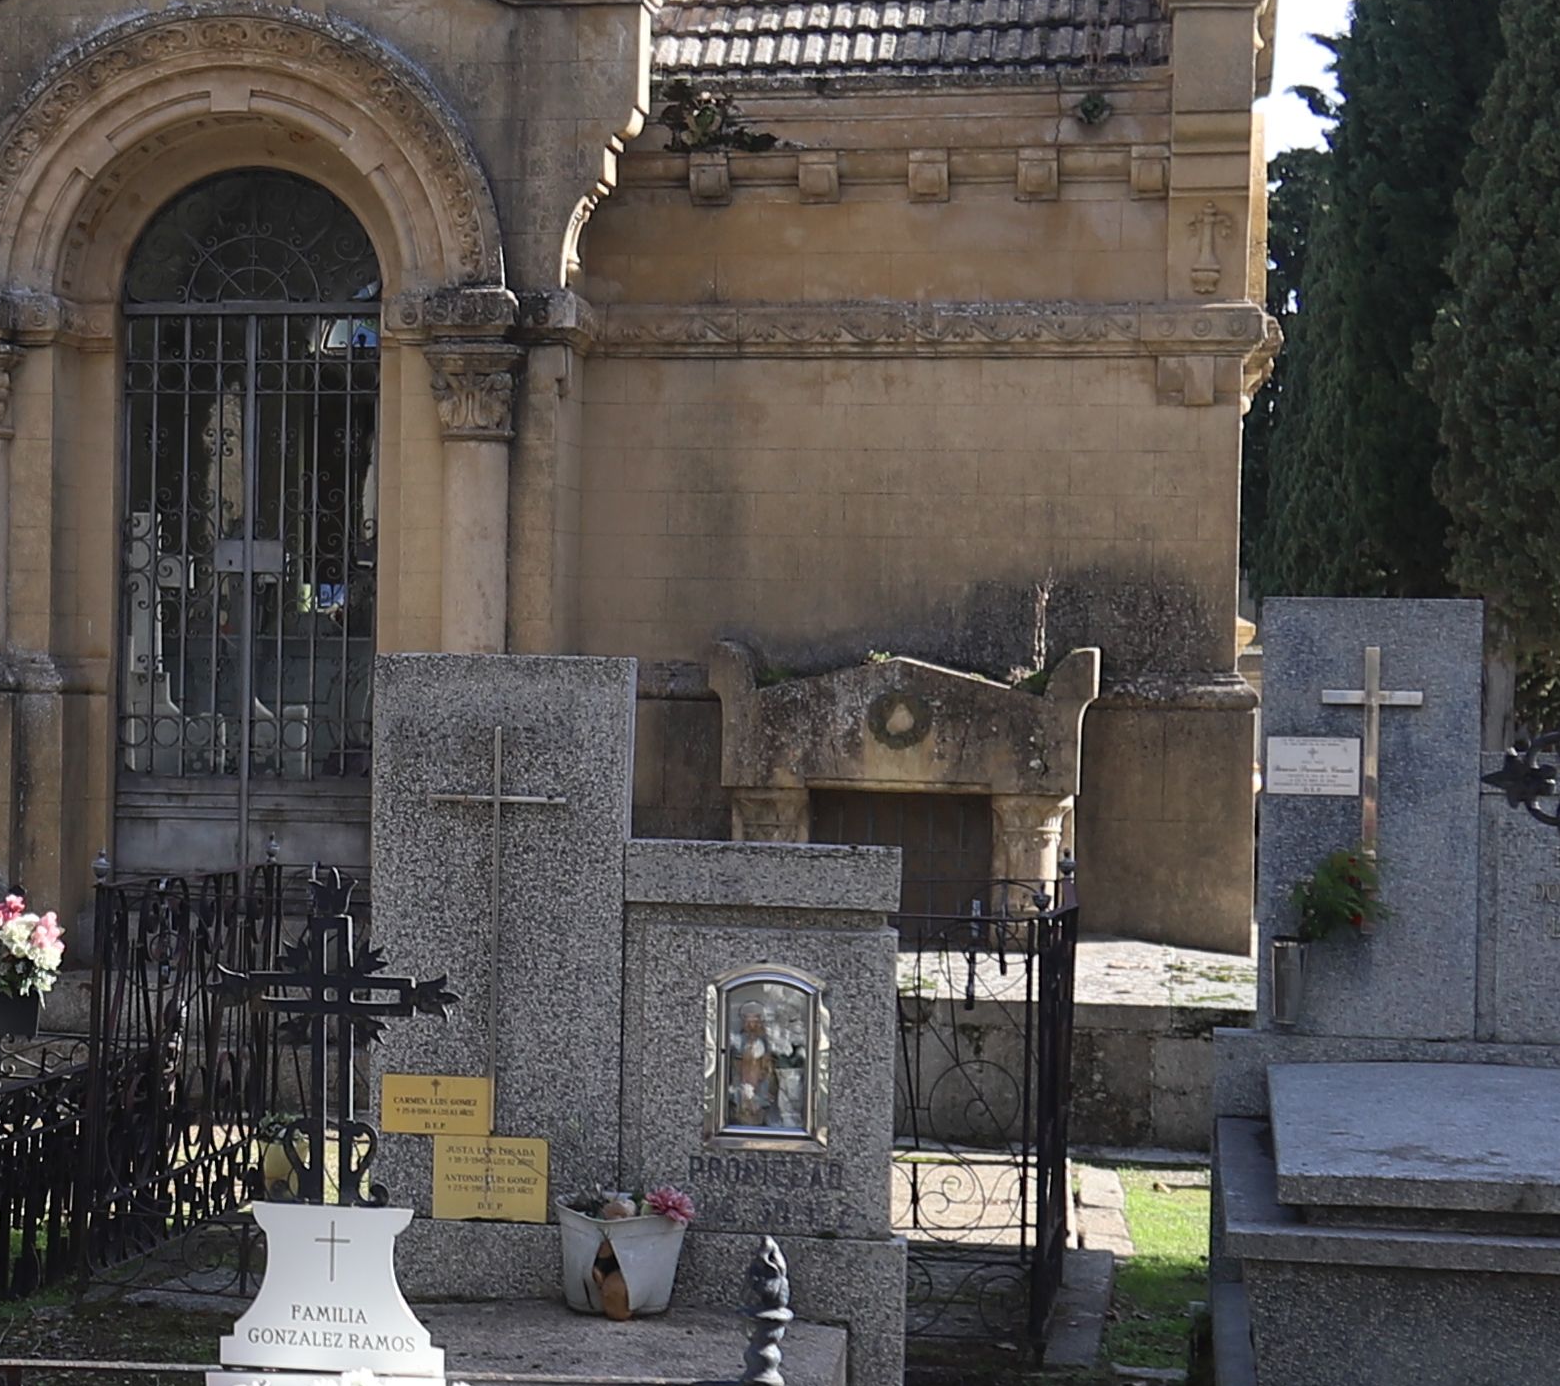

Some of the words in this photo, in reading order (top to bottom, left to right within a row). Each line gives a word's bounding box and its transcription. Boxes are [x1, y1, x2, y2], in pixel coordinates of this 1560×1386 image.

[393, 1096, 427, 1105] CARMEN
[430, 1097, 448, 1105] LUIS
[446, 1145, 474, 1155] JUSTA
[444, 1173, 483, 1182] ANTONIO
[507, 1176, 538, 1186] GOMEZ
[291, 1304, 368, 1325] FAMILIA
[248, 1327, 343, 1349] GONZALEZ
[348, 1332, 416, 1353] RAMOS
